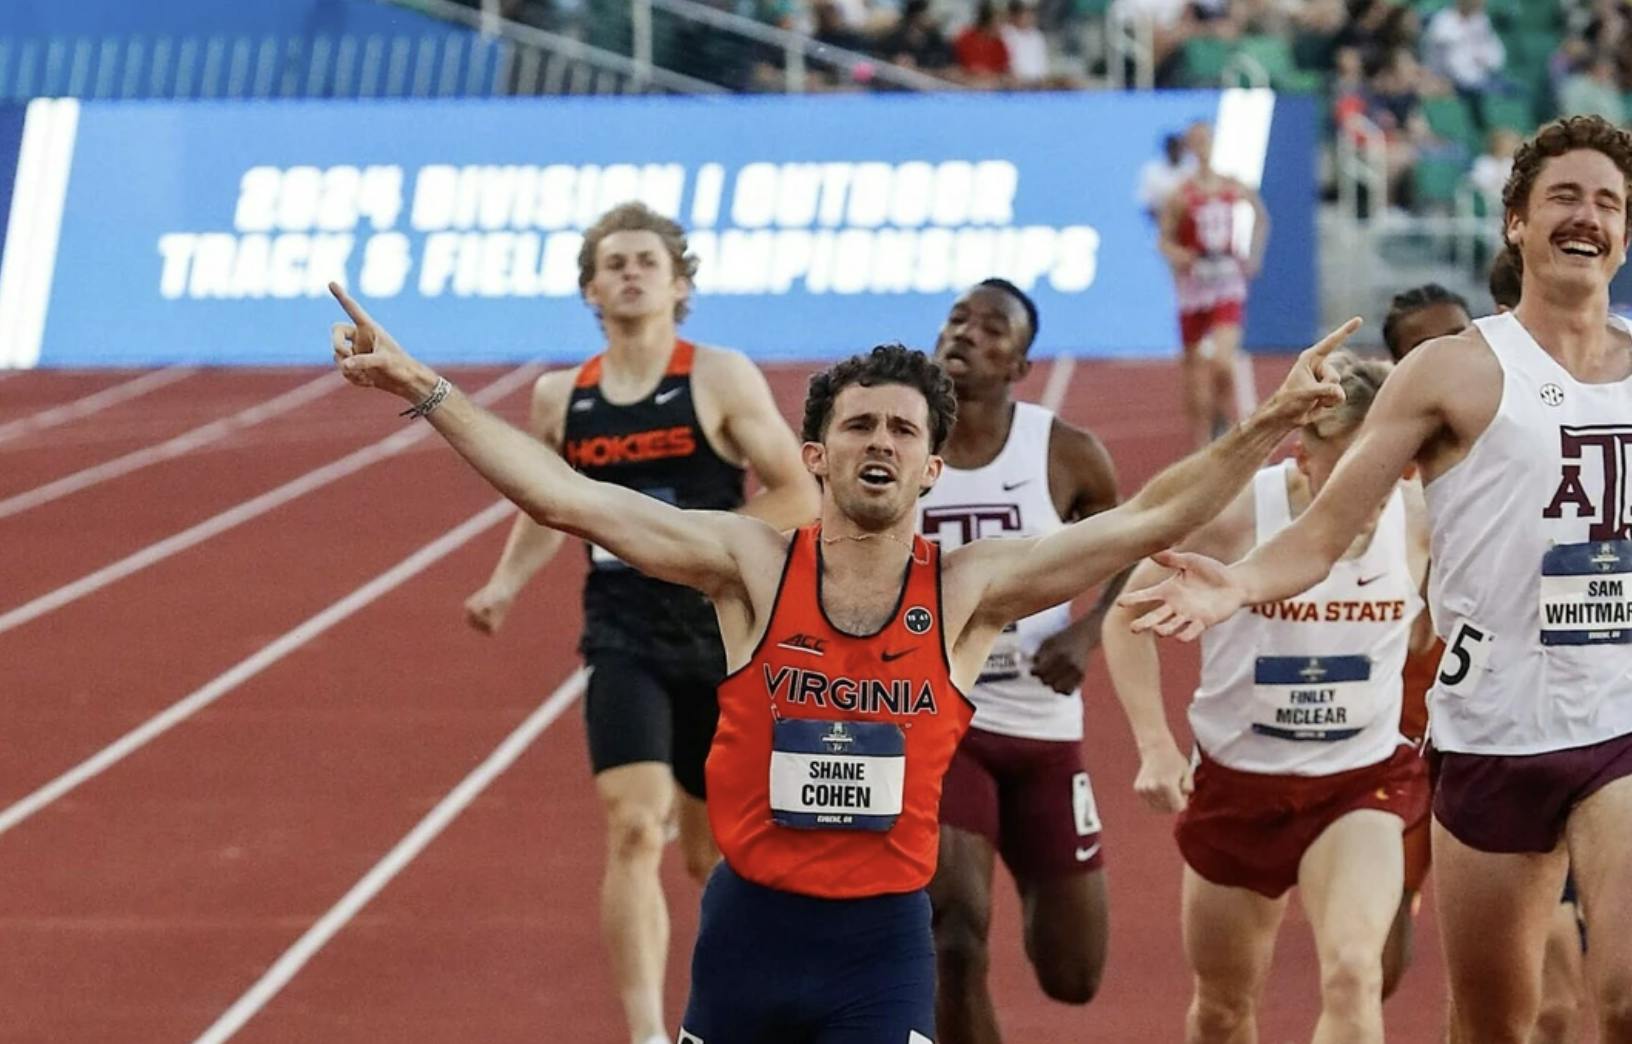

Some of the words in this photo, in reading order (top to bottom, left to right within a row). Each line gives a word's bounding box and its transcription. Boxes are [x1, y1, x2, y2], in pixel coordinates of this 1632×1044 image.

[236, 165, 403, 232] 2024
[412, 163, 685, 231] DIVISION
[732, 160, 1017, 226] OUTDOOR
[158, 232, 353, 299] TRACK
[360, 232, 411, 298] &
[567, 425, 696, 466] HOKIES
[1588, 580, 1623, 597] SAM
[1325, 600, 1405, 622] STATE
[1439, 623, 1484, 686] 5
[764, 664, 937, 714] VIRGINIA
[1290, 689, 1335, 704] FINLEY
[1276, 707, 1347, 725] MCLEAR
[809, 761, 865, 780] SHANE
[801, 784, 871, 808] COHEN
